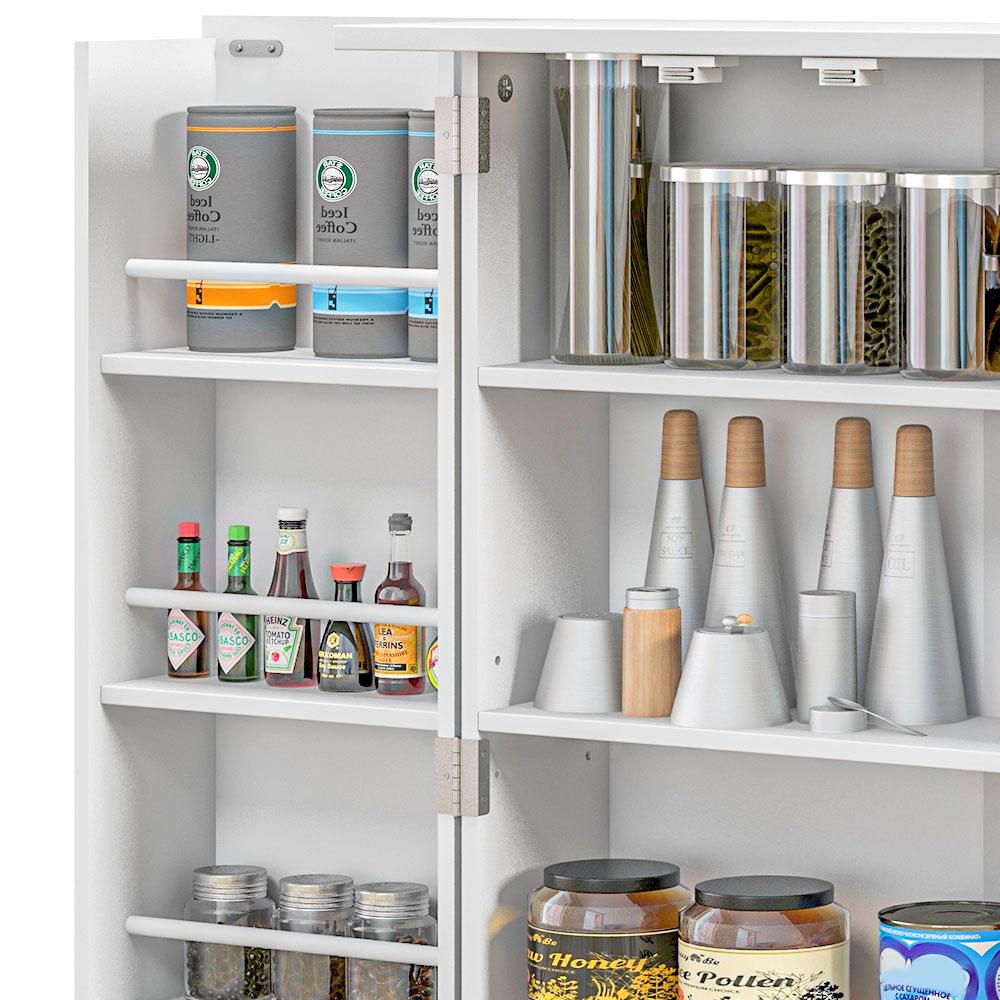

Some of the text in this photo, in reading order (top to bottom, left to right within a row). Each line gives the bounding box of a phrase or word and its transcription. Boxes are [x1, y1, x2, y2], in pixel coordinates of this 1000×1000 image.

[887, 557, 911, 571] OIL
[266, 616, 288, 626] HEINZ
[549, 952, 648, 973] Honey
[697, 971, 798, 988] Pollen
